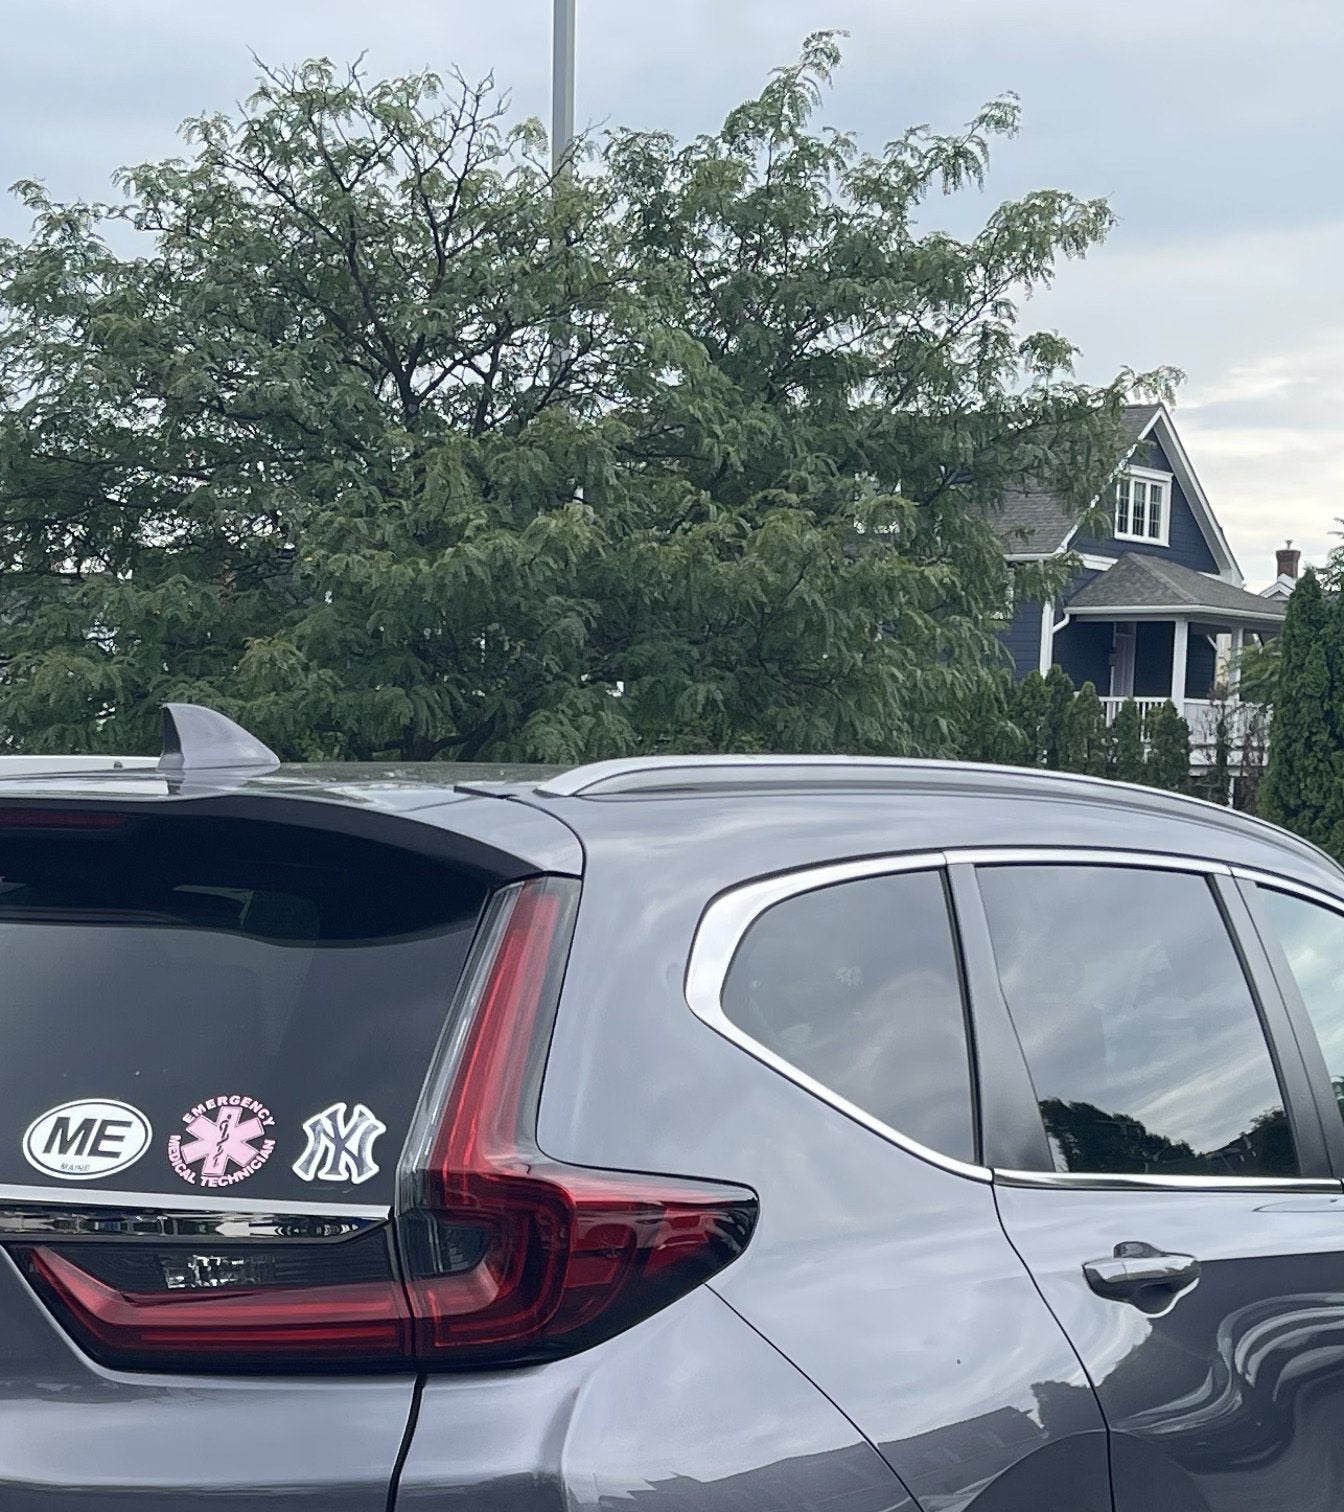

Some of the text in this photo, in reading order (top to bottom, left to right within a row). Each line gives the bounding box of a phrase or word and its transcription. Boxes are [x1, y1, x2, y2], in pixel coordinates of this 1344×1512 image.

[182, 1095, 276, 1127] EMERGENCY
[42, 1116, 133, 1159] ME
[168, 1134, 276, 1188] MEDICAL TECHNICIAN
